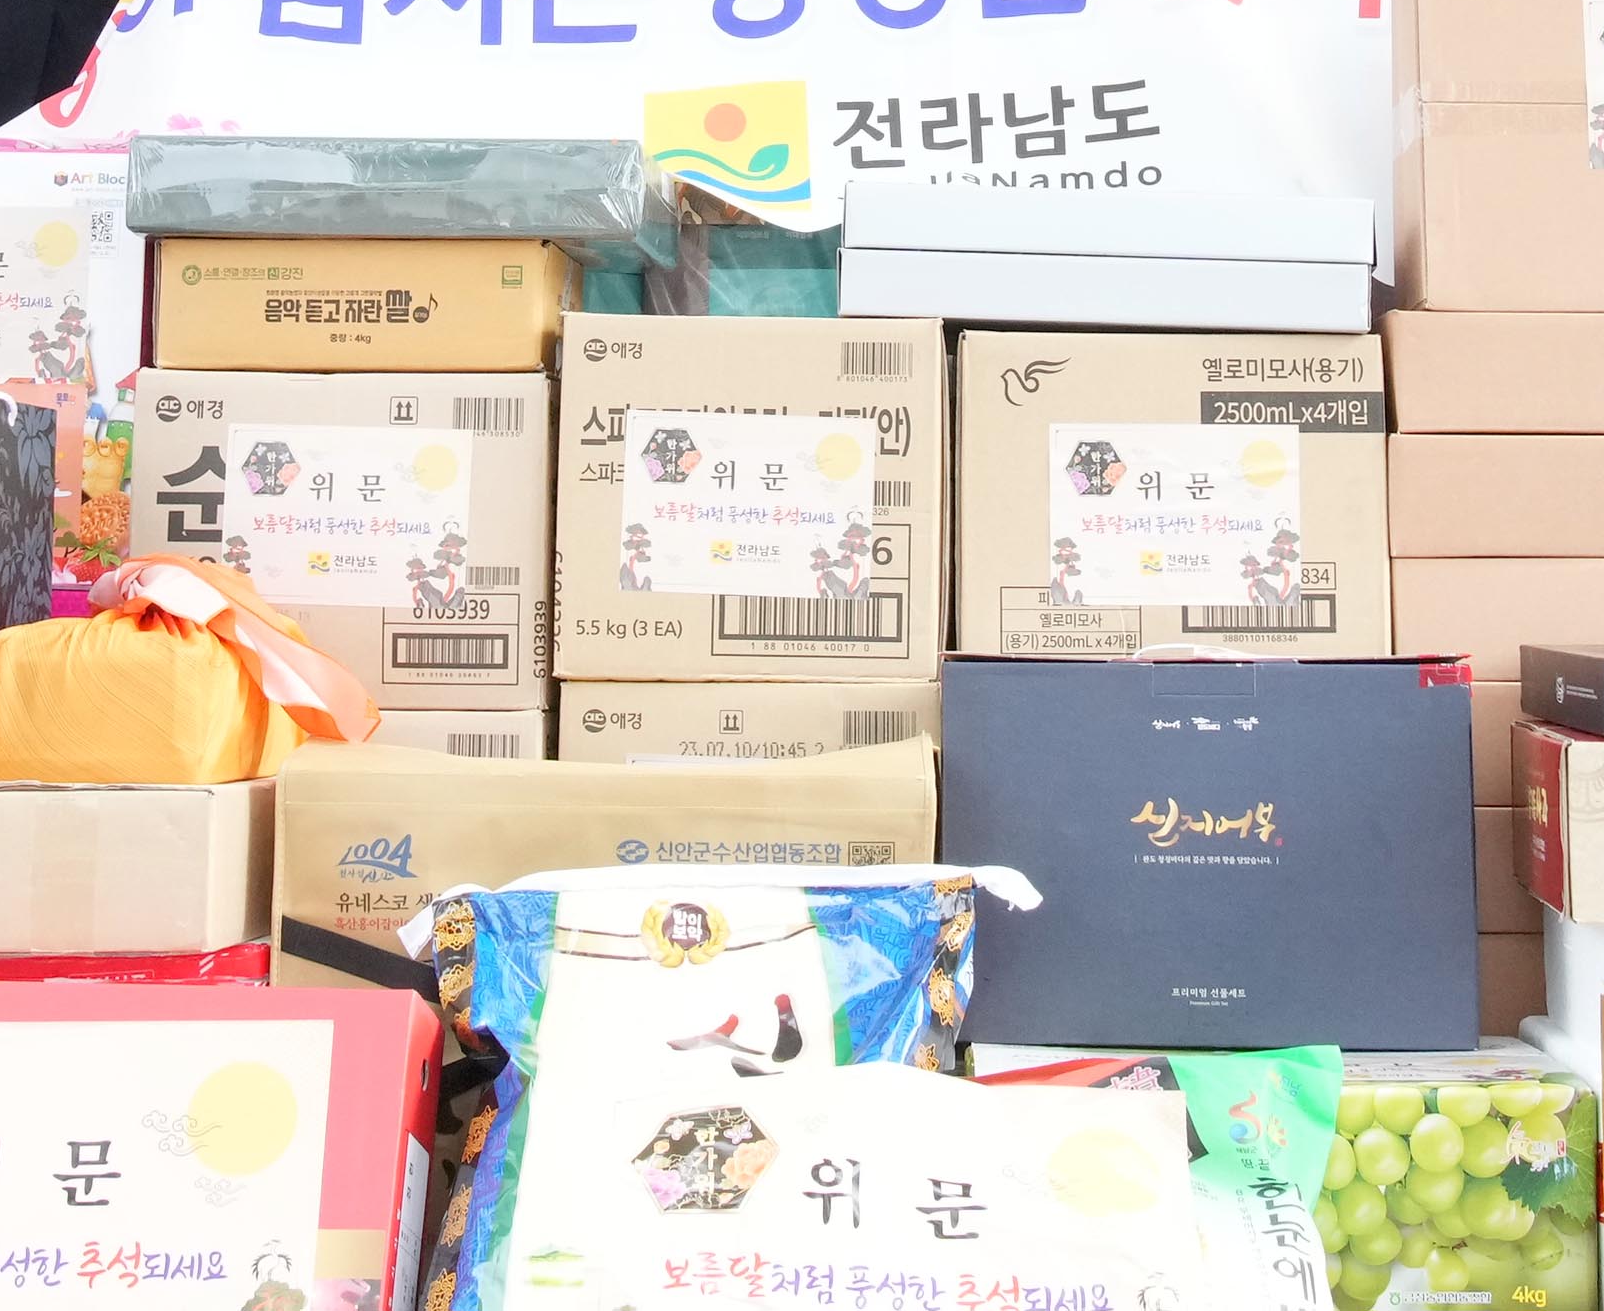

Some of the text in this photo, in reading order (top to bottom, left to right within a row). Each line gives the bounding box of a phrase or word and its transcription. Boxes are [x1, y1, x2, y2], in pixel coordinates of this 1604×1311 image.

[832, 78, 1161, 169] 전라남도
[265, 289, 413, 324] 음악 듣고 자란 쌀
[354, 334, 372, 344] 4kg
[611, 341, 643, 360] 애경
[1201, 357, 1365, 384] 옐로미모사(용기)
[186, 399, 225, 420] 애경
[1213, 400, 1369, 425] 2500mLx4개입
[654, 502, 837, 526] 보름달처럼 풍성한 추석되세요
[1081, 514, 1264, 535] 보름달처럼 풍성한 추석되세요
[253, 514, 432, 537] 보름달처럼 풍성한 추석되세요
[333, 553, 378, 569] 전라남도
[736, 543, 782, 557] 전라남도
[1166, 553, 1211, 566] 전라남도
[575, 618, 684, 642] 5.5 kg (3 EA)
[1039, 612, 1102, 628] 옐로미모사
[533, 600, 546, 679] 6103939
[763, 642, 776, 652] 88
[783, 642, 817, 653] 01046
[823, 642, 858, 653] 40017
[1005, 633, 1137, 650] (용기) 2500mL x 4개입
[609, 712, 642, 730] 애경
[654, 839, 842, 866] 신안군수산업협동조합
[335, 892, 409, 914] 유네스코
[1171, 987, 1247, 999] 프리미엄 선물세트
[75, 1240, 230, 1289] 추석되세요
[662, 1250, 835, 1304] 보름달처럼
[845, 1264, 946, 1311] 풍성한
[1511, 1285, 1547, 1308] 4kg
